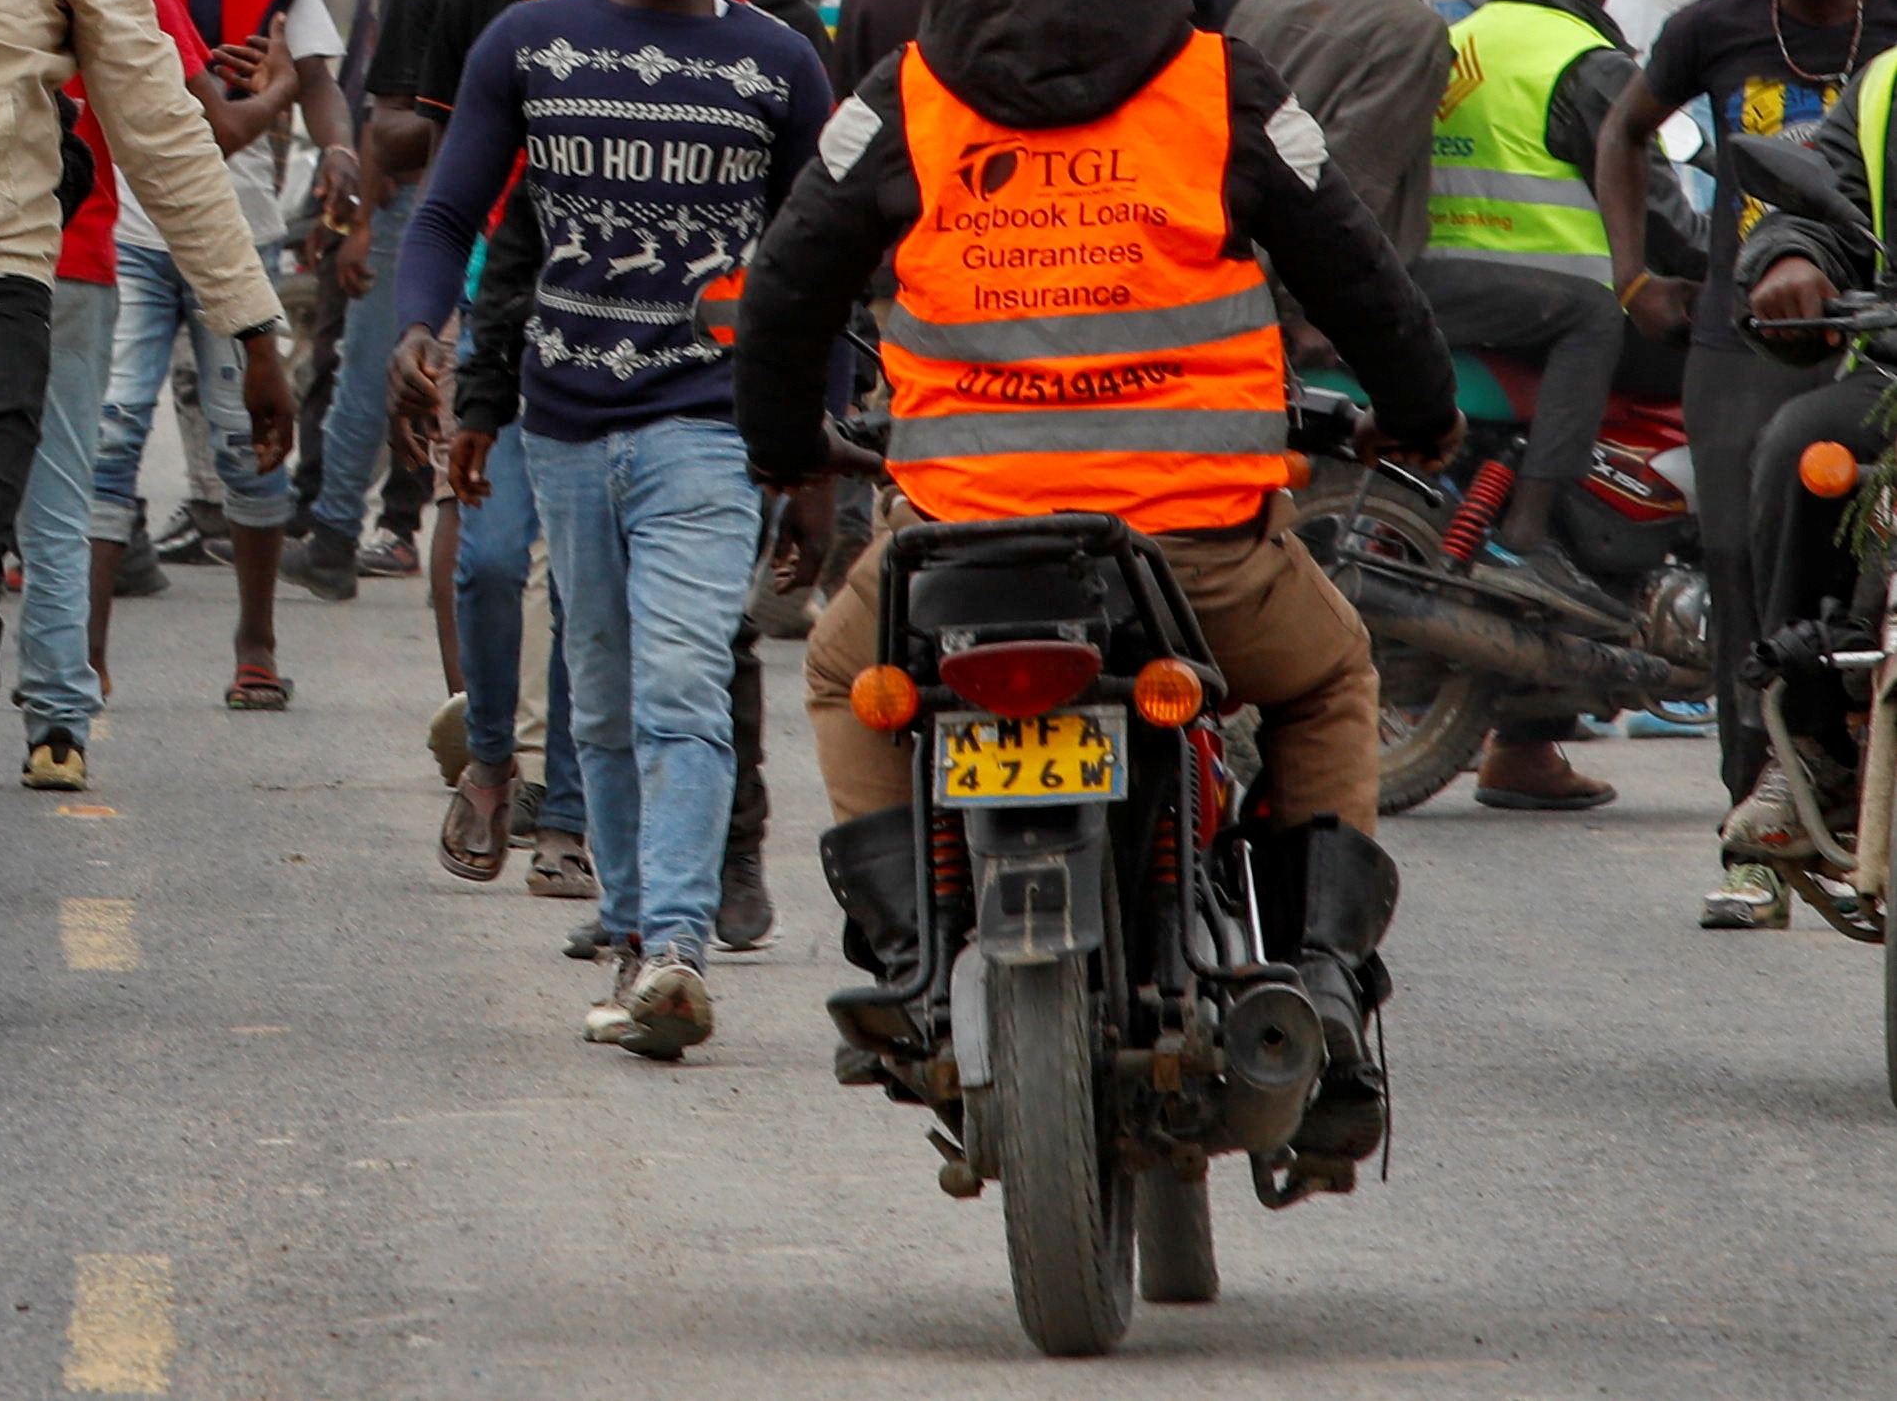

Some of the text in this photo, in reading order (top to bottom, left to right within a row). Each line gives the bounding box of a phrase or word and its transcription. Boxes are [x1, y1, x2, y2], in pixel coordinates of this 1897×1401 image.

[547, 134, 595, 178] HO
[602, 136, 655, 183] HO
[660, 140, 715, 185] HO
[1032, 147, 1139, 189] TGL
[936, 201, 1169, 237] Logbook Loans
[962, 241, 1145, 271] Guarantees
[974, 283, 1132, 311] Insurance
[957, 759, 1105, 790] 476W
